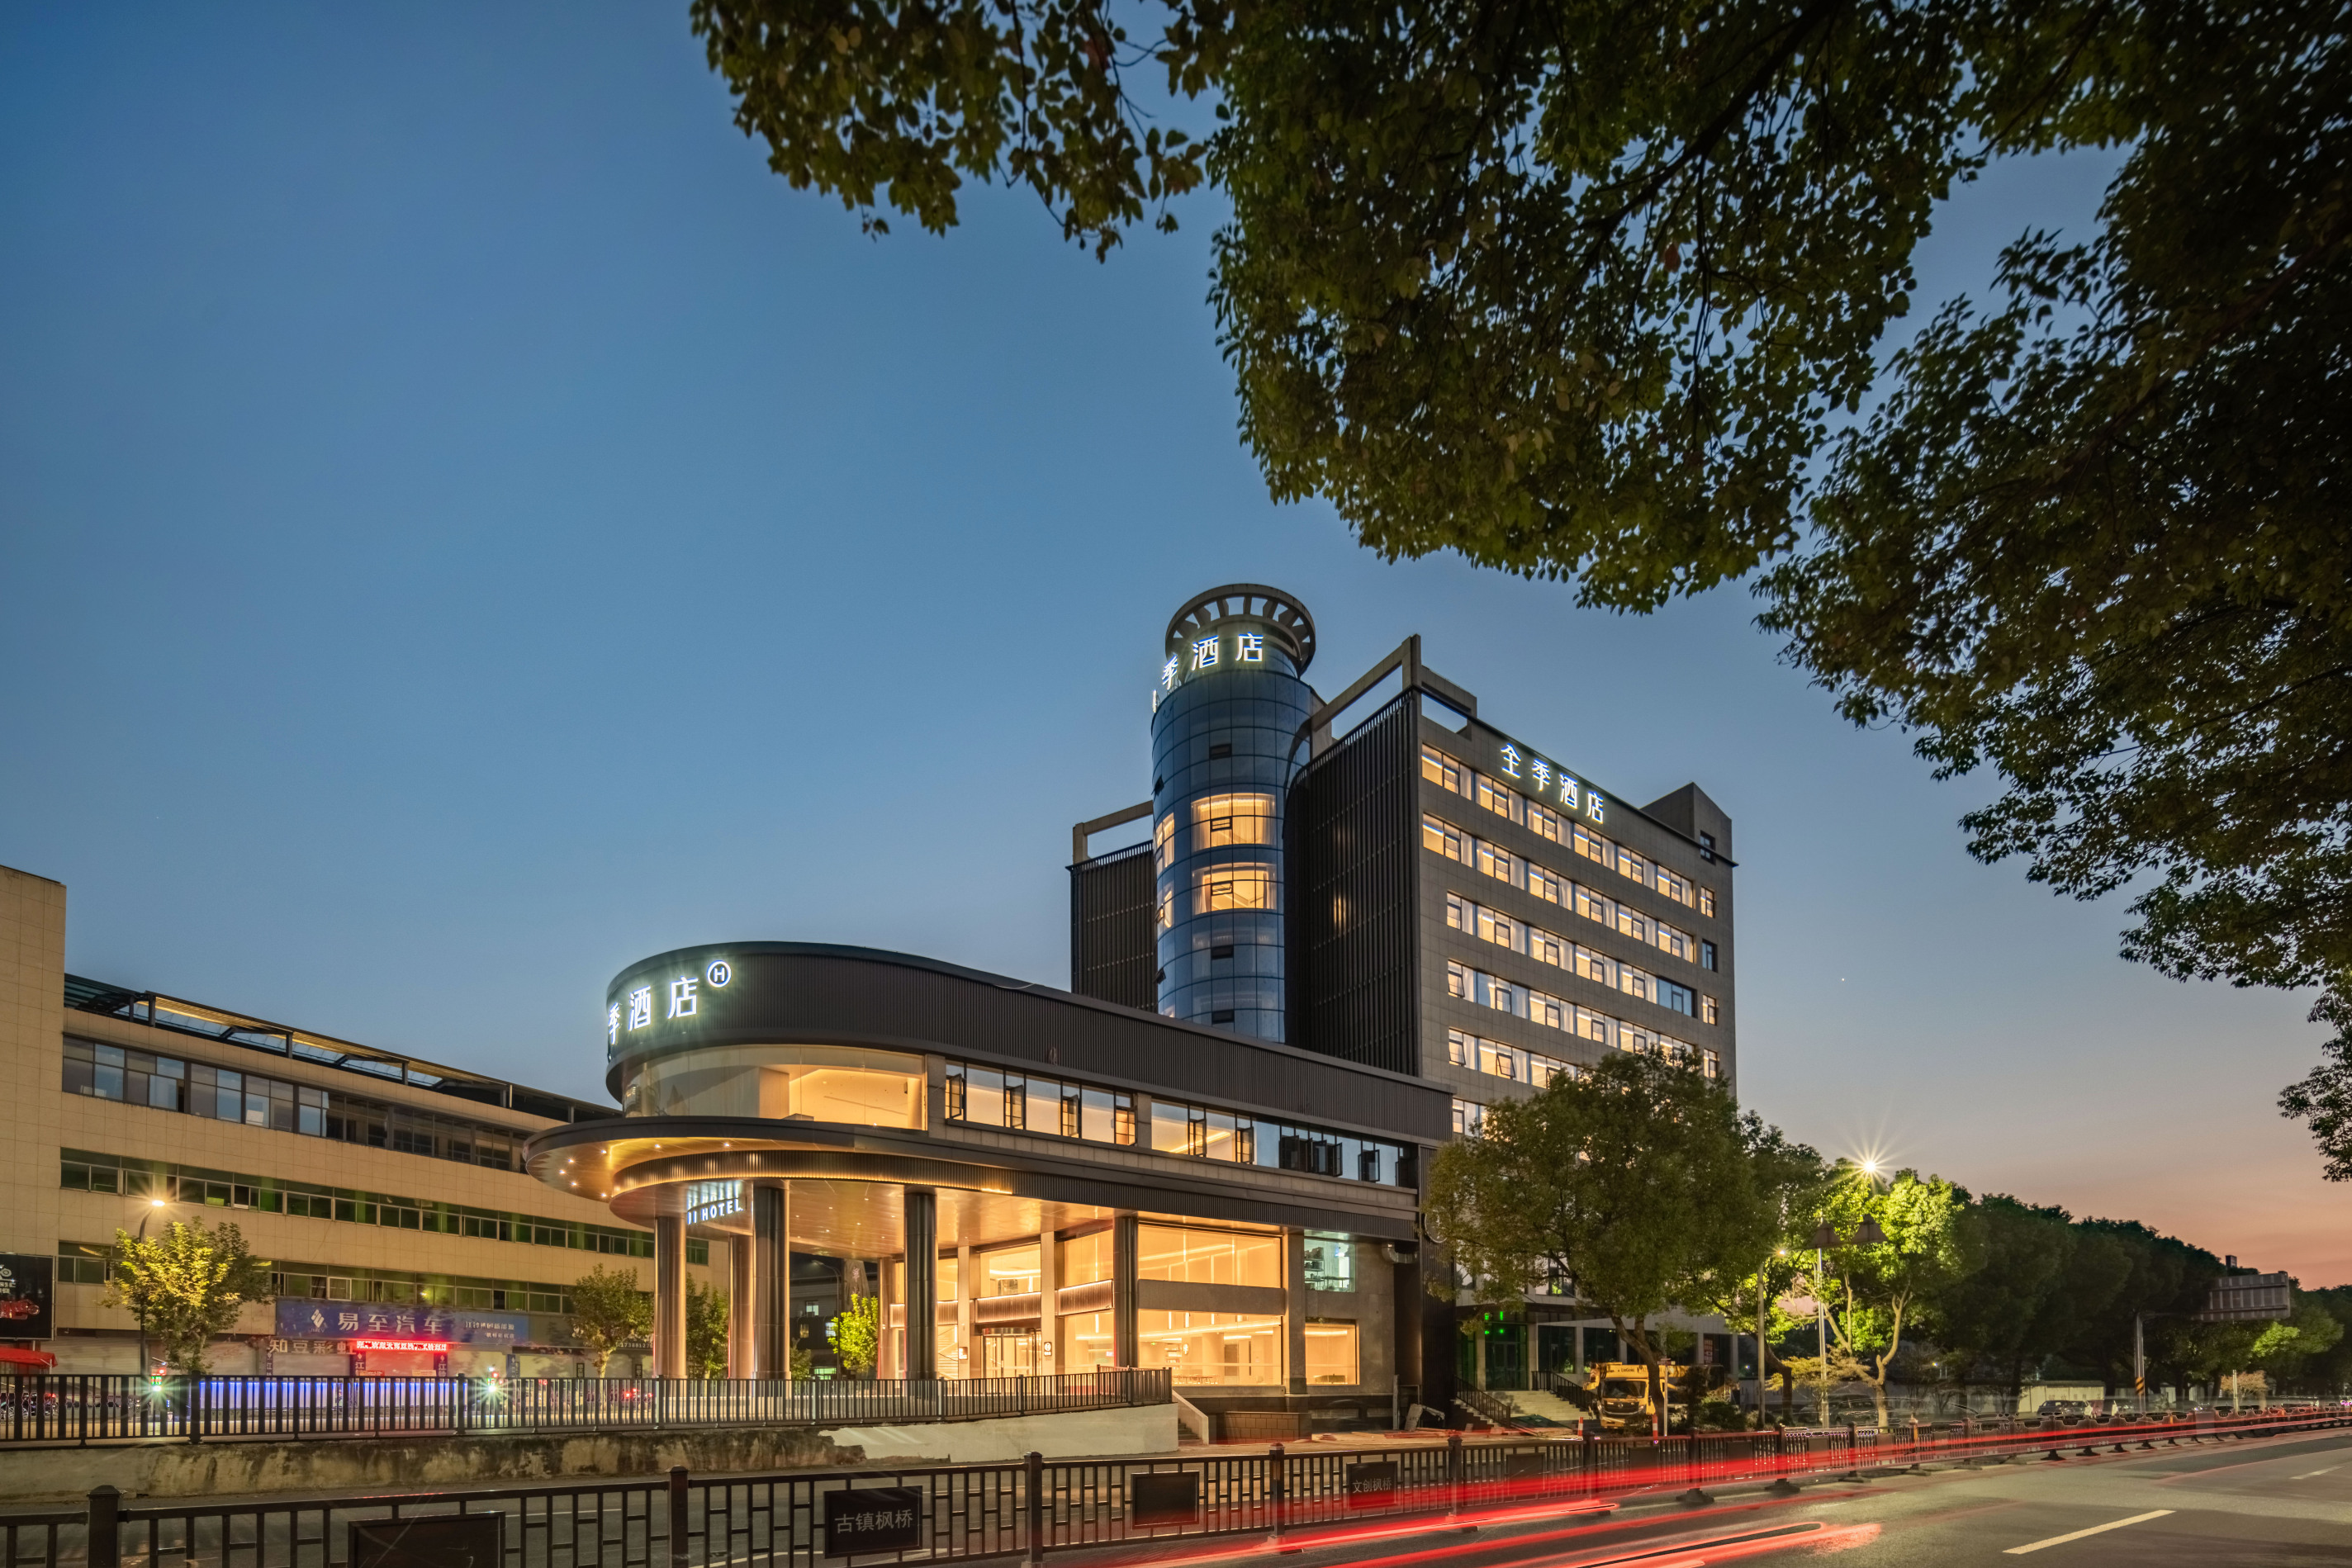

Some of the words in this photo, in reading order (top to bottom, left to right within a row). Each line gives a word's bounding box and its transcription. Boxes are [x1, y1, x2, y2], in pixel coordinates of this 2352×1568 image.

[1152, 631, 1264, 713] 季酒店
[1500, 743, 1605, 824] 全季酒店
[700, 1198, 743, 1221] HOTEL
[337, 1311, 443, 1334] 易至汽车
[269, 1338, 357, 1355] 知豆彩虹
[1352, 1477, 1392, 1494] 文创枫桥
[834, 1509, 913, 1534] 古镇枫桥
